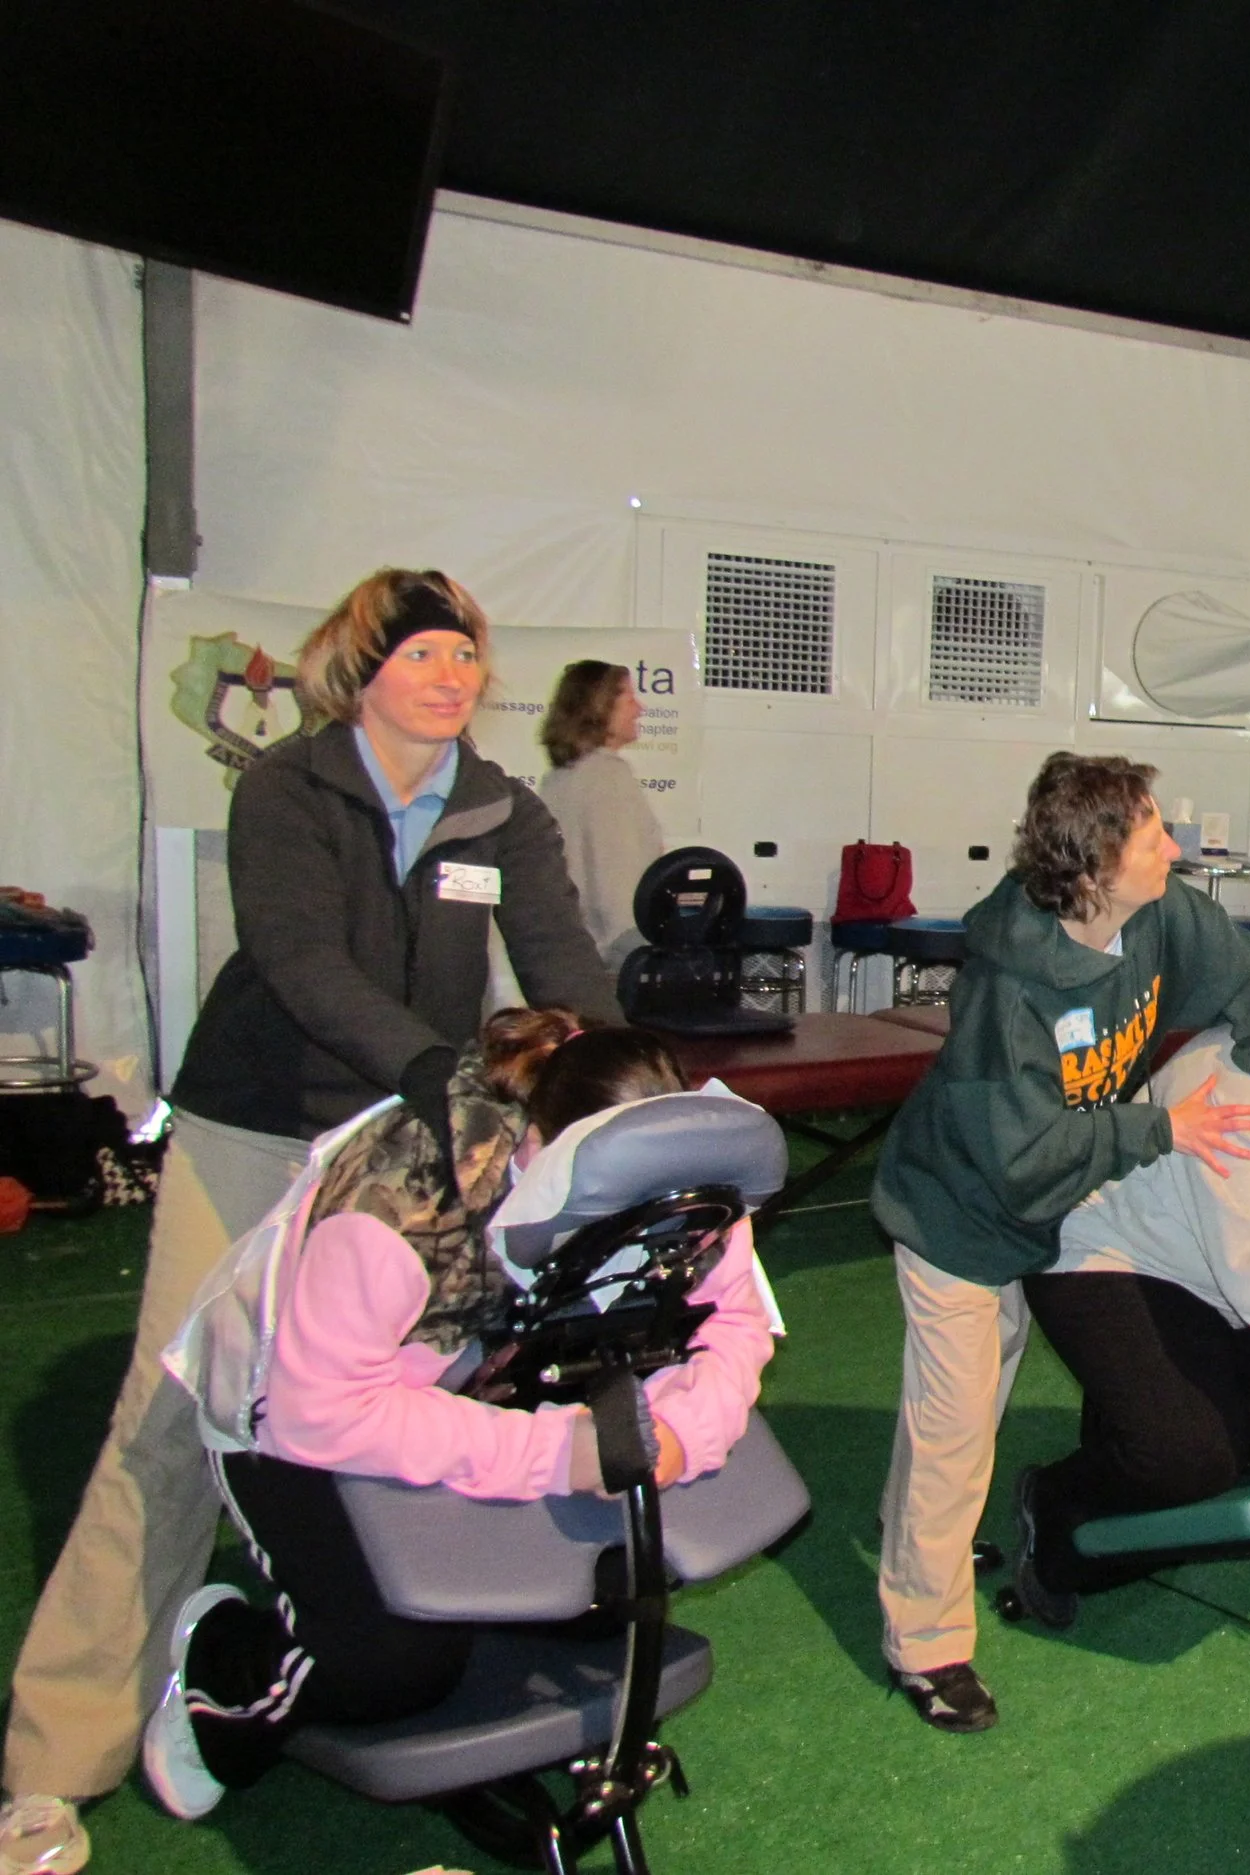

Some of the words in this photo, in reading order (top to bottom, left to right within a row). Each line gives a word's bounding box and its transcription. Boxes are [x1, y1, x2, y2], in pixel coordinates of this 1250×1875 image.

[636, 660, 675, 695] ta
[638, 722, 679, 737] hapter
[640, 776, 677, 793] sage
